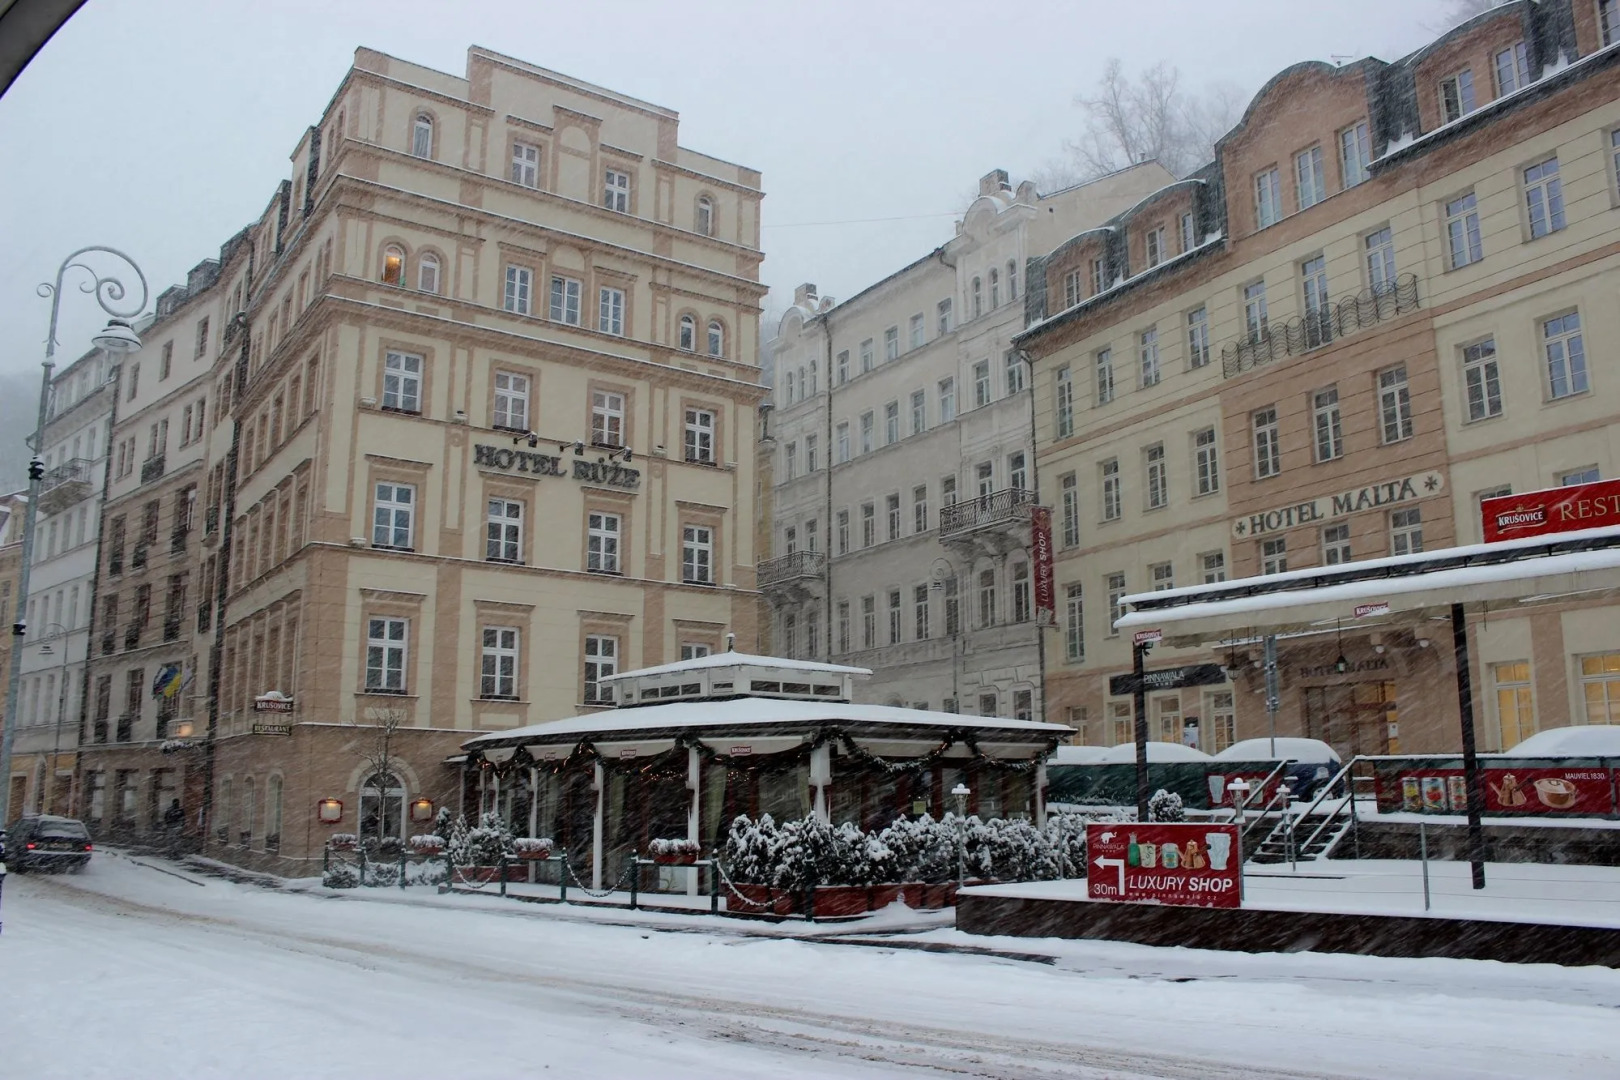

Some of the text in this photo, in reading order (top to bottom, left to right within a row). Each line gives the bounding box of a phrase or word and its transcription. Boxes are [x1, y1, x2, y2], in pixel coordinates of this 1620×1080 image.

[474, 445, 641, 488] HOTEL RŮŽE
[1250, 478, 1417, 533] HOTEL MALTA
[1560, 494, 1620, 521] REST
[1498, 511, 1543, 526] KRUŠOVICE
[1039, 532, 1049, 602] LUXURY SHOP
[1144, 671, 1185, 683] PINNAWALA
[1093, 883, 1118, 896] 30m
[1129, 875, 1233, 893] LUXURY SHOP
